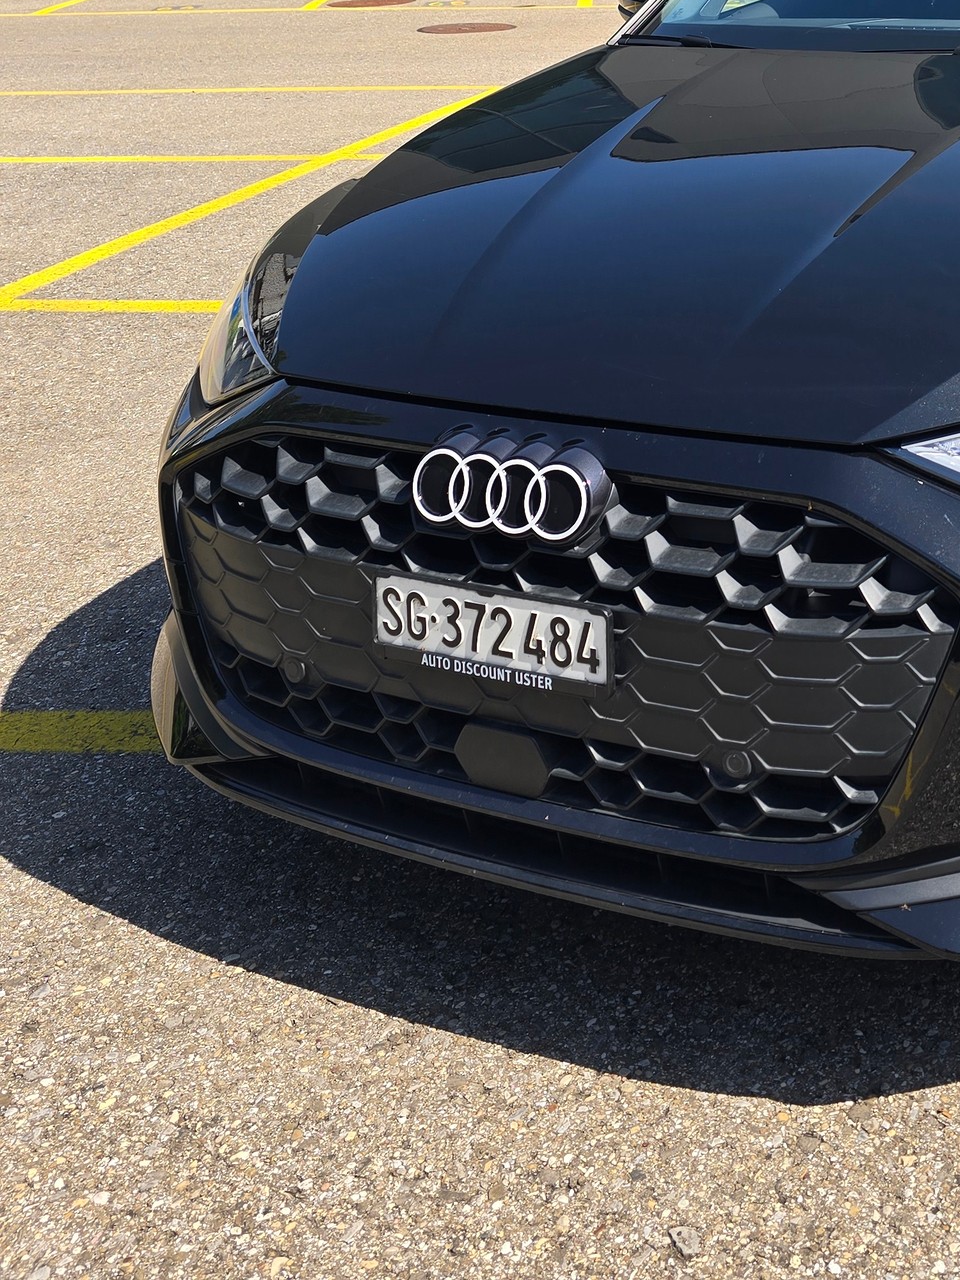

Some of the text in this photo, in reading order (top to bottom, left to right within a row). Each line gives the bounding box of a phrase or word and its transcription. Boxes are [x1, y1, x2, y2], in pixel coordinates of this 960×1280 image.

[421, 653, 553, 691] AUTO DISCOUNT USTER
